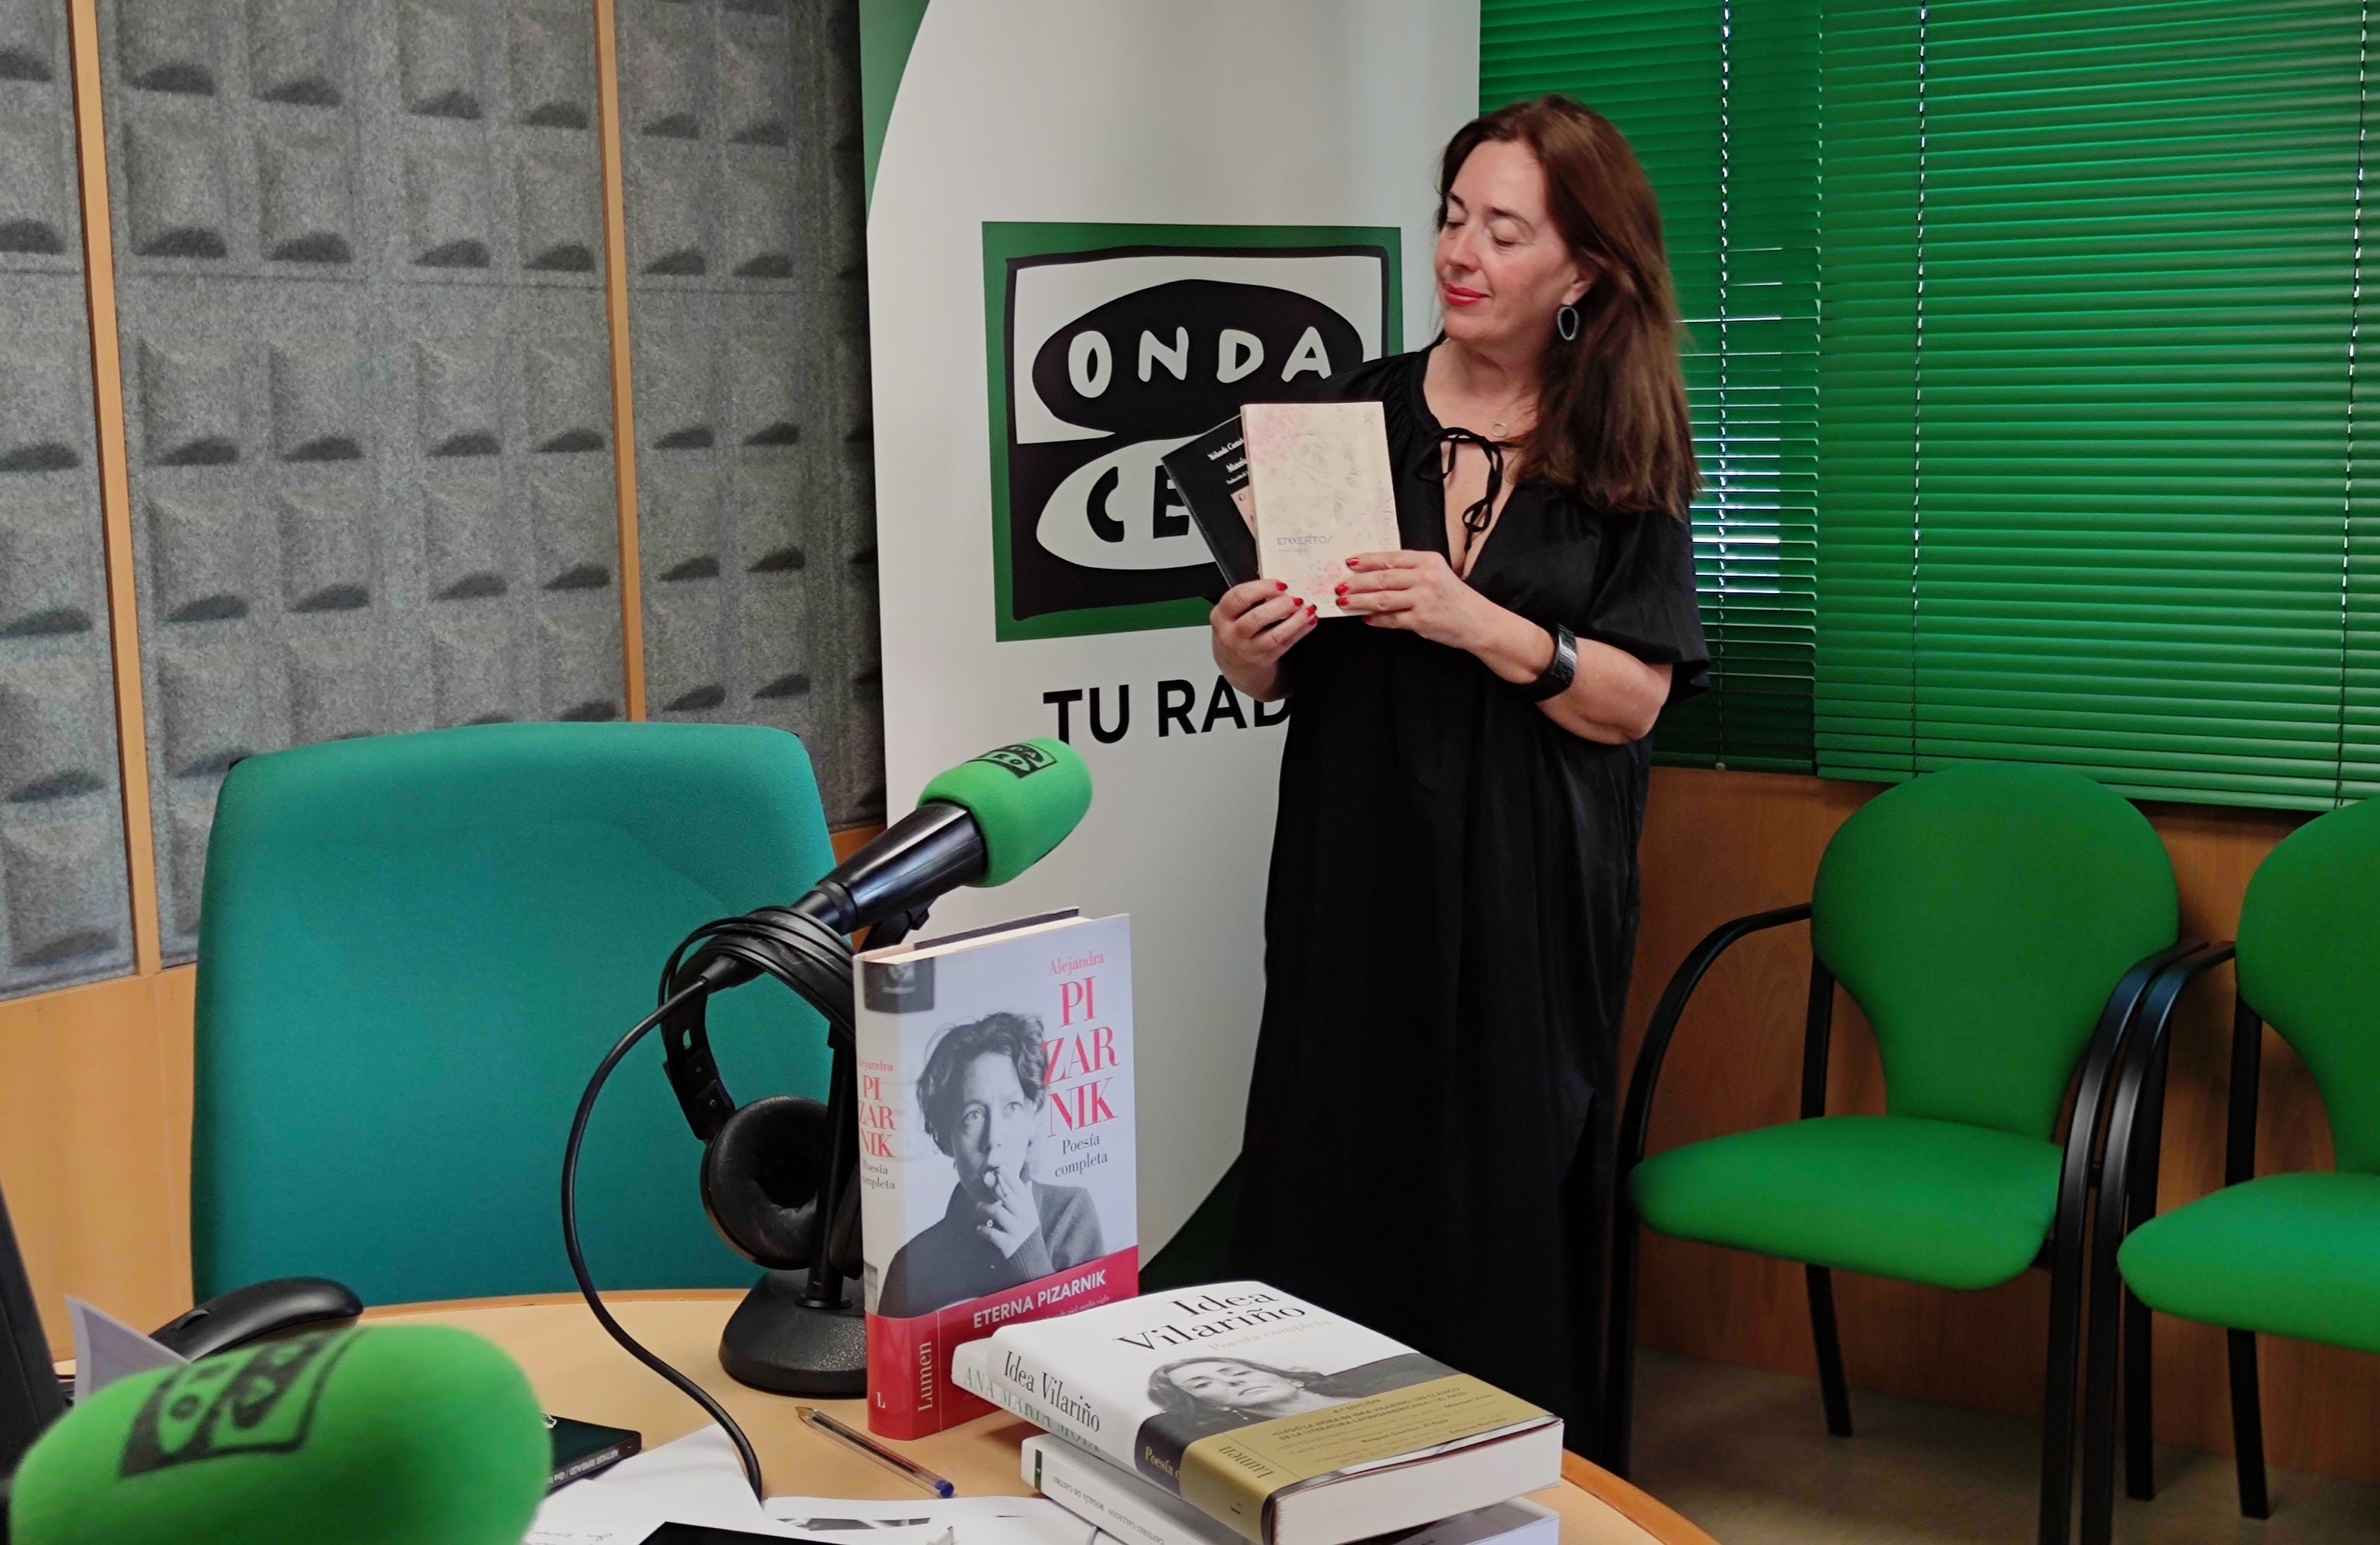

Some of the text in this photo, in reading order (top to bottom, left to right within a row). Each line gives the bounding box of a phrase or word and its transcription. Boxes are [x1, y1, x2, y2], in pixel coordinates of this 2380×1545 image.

[1068, 326, 1332, 399] ONDA
[1086, 464, 1190, 543] CE
[1042, 674, 1292, 744] TU RAD
[1048, 951, 1105, 978] Alejandra
[1058, 976, 1098, 1028] PI
[858, 1059, 895, 1073] lejandra
[1042, 1025, 1121, 1087] ZAR
[862, 1074, 882, 1102] PI
[858, 1100, 897, 1131] ZAR
[1046, 1076, 1119, 1139] NIK
[860, 1130, 895, 1159] NIK
[1062, 1132, 1101, 1156] Poesía
[862, 1158, 889, 1176] Poesía
[1054, 1152, 1109, 1178] completa
[973, 1268, 1107, 1329] ETERNA PIZARNIK
[1165, 1292, 1281, 1317] Idea
[1111, 1306, 1306, 1350] Vilariño
[1206, 1319, 1333, 1352] Poesía completa
[918, 1340, 933, 1412] Lumen
[963, 1366, 995, 1399] ANA
[1004, 1350, 1101, 1433] Idea Vilariño
[876, 1391, 886, 1409] L
[1144, 1445, 1174, 1477] Poesía
[1219, 1445, 1275, 1478] Lumen
